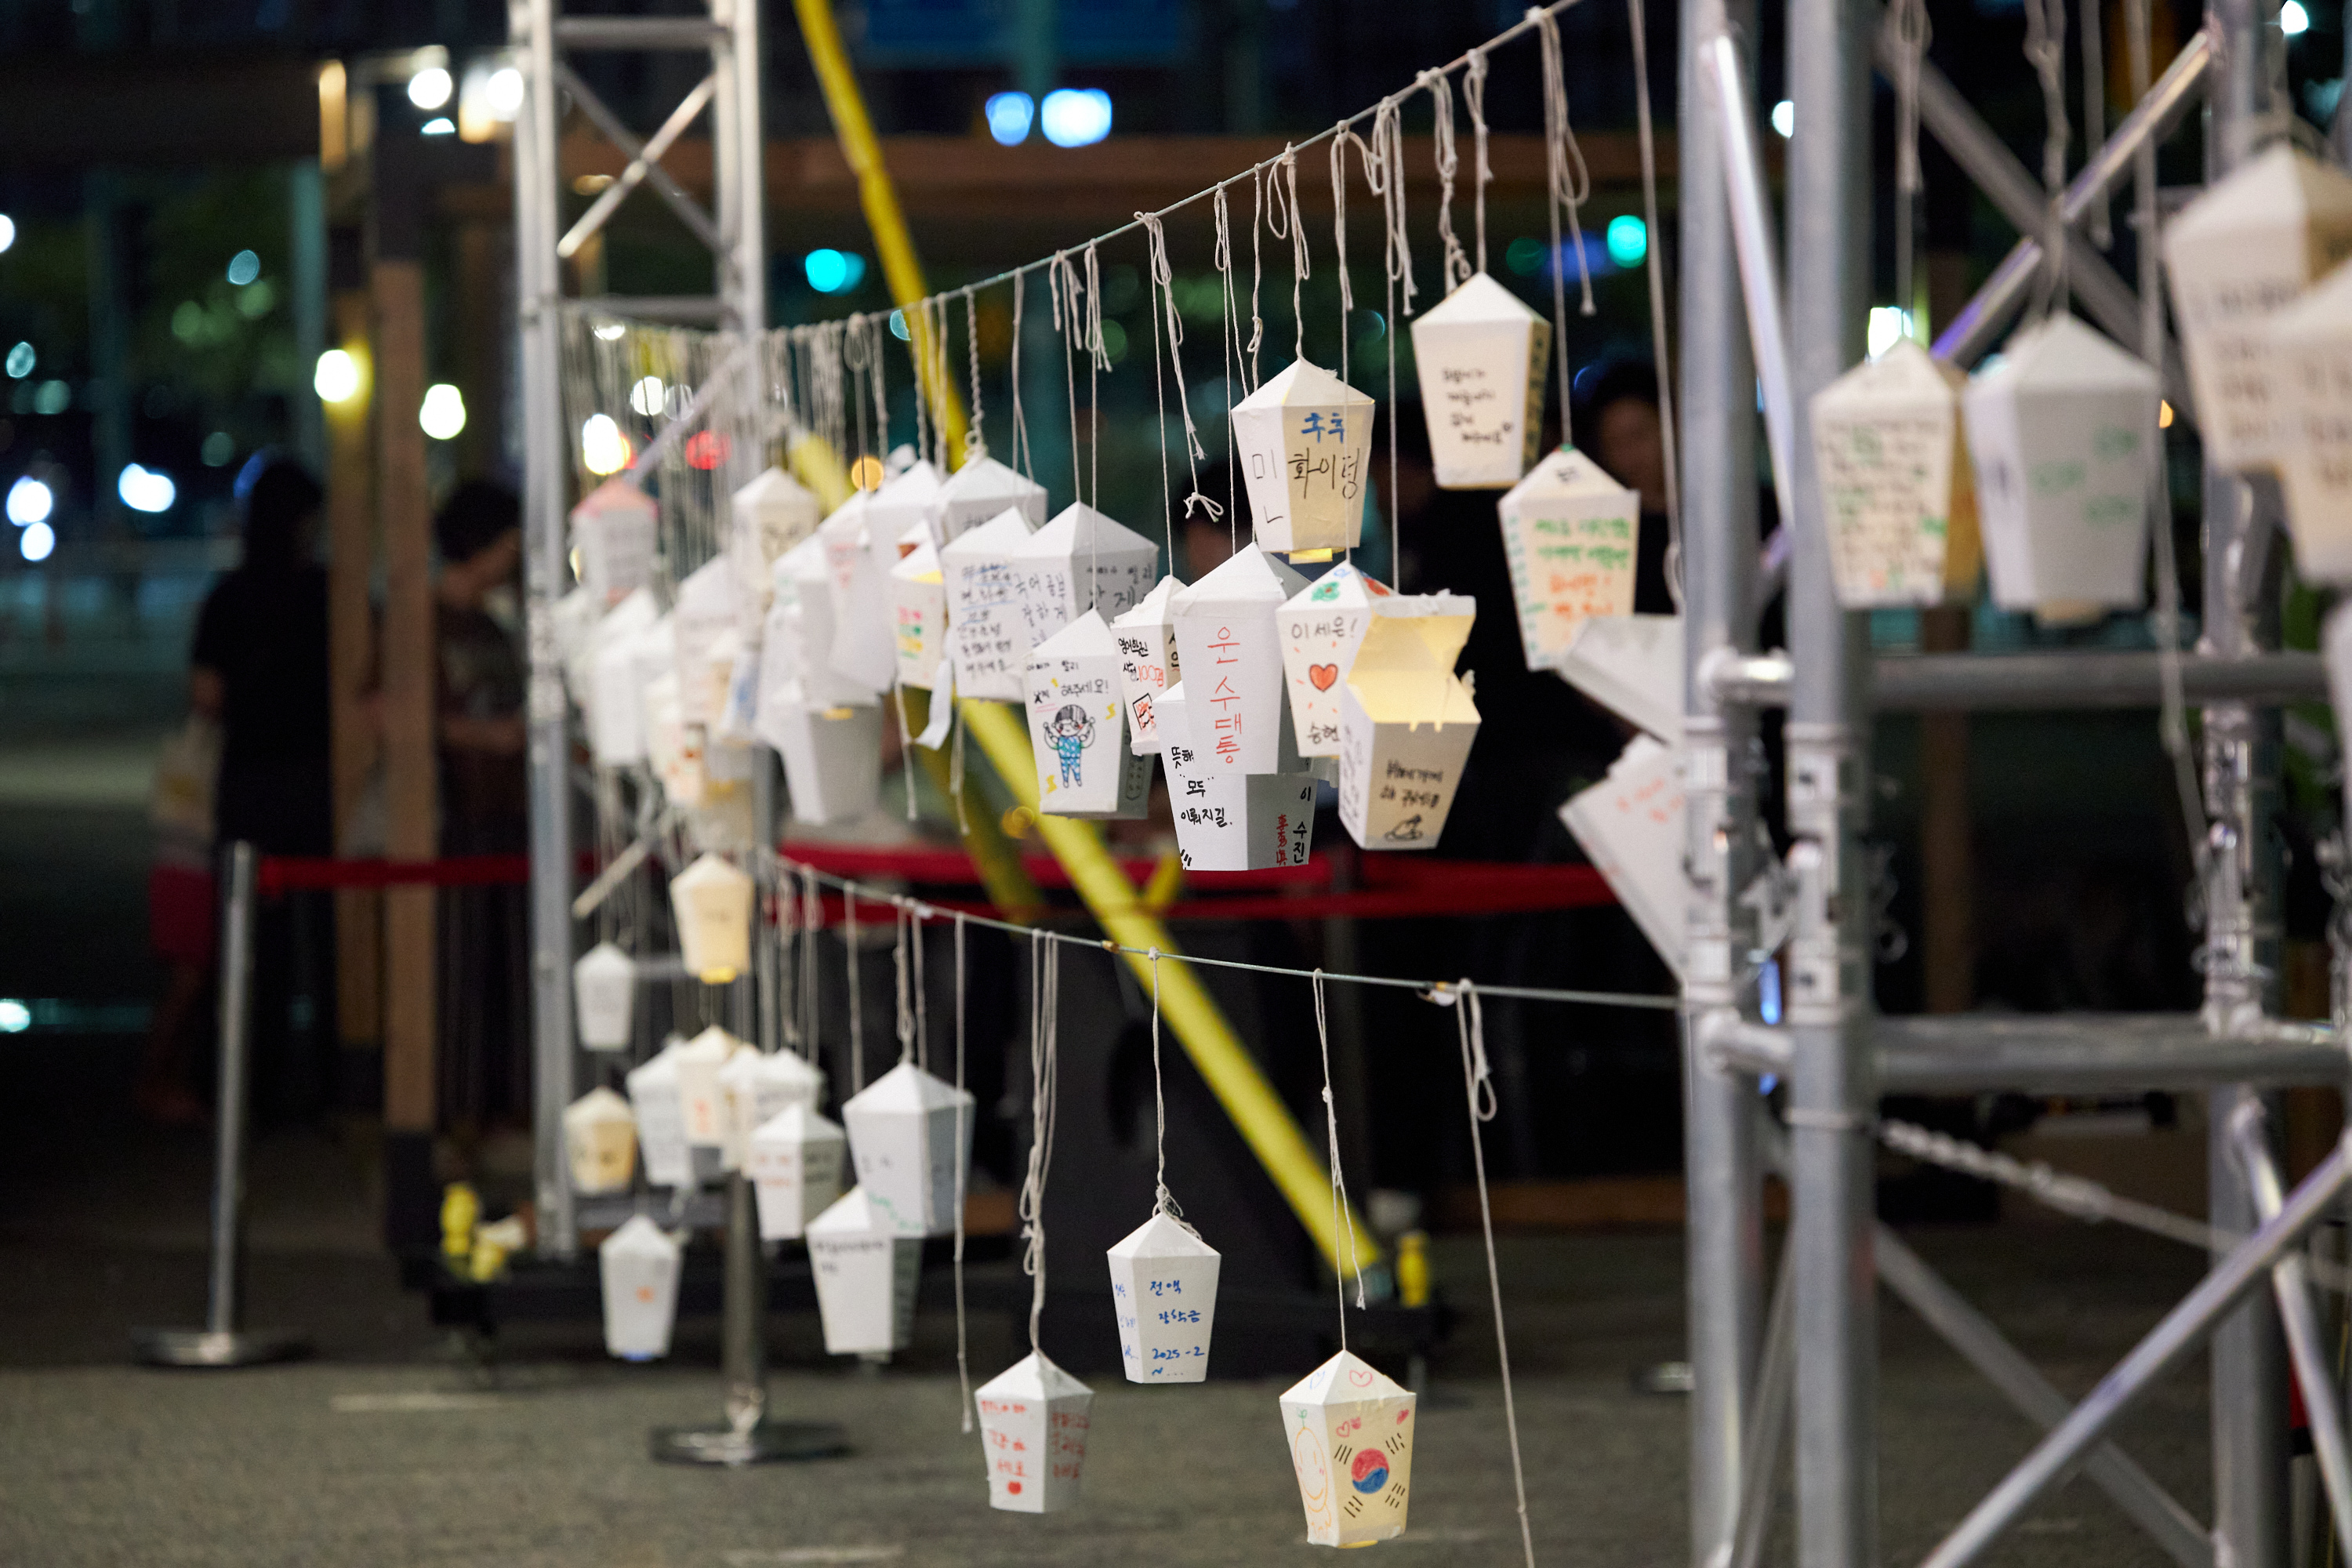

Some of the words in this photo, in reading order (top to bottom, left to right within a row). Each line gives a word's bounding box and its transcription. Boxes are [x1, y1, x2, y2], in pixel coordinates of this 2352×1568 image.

[1118, 637, 1149, 657] 영어학원
[1207, 626, 1243, 764] 운수대통
[1149, 1279, 1182, 1296] 전액
[1158, 1308, 1201, 1324] 장학금
